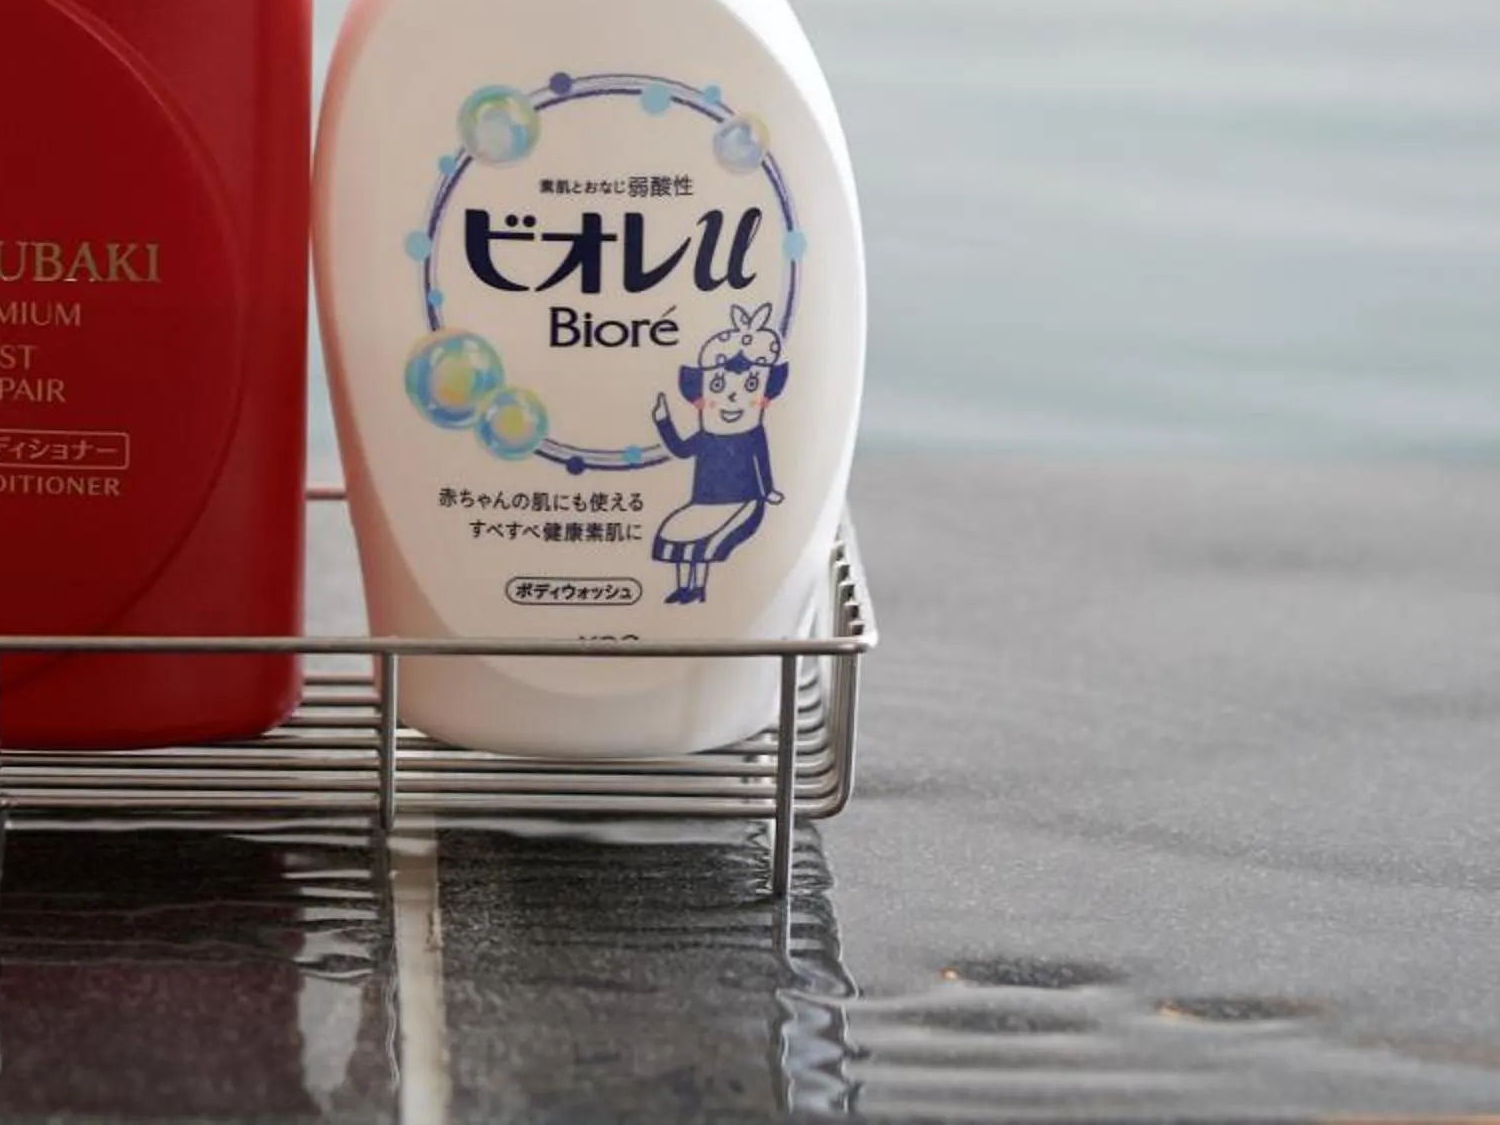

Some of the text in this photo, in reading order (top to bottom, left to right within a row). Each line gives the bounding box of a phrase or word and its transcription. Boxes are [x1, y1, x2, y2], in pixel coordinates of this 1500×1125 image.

[539, 175, 695, 198] 素肌とおなじ弱酸性
[548, 305, 679, 348] Bioré
[438, 488, 643, 513] 赤ちゃんの肌にも使える
[469, 521, 643, 543] すべすべ健康素肌に
[515, 583, 633, 601] ボディウォッシュ
